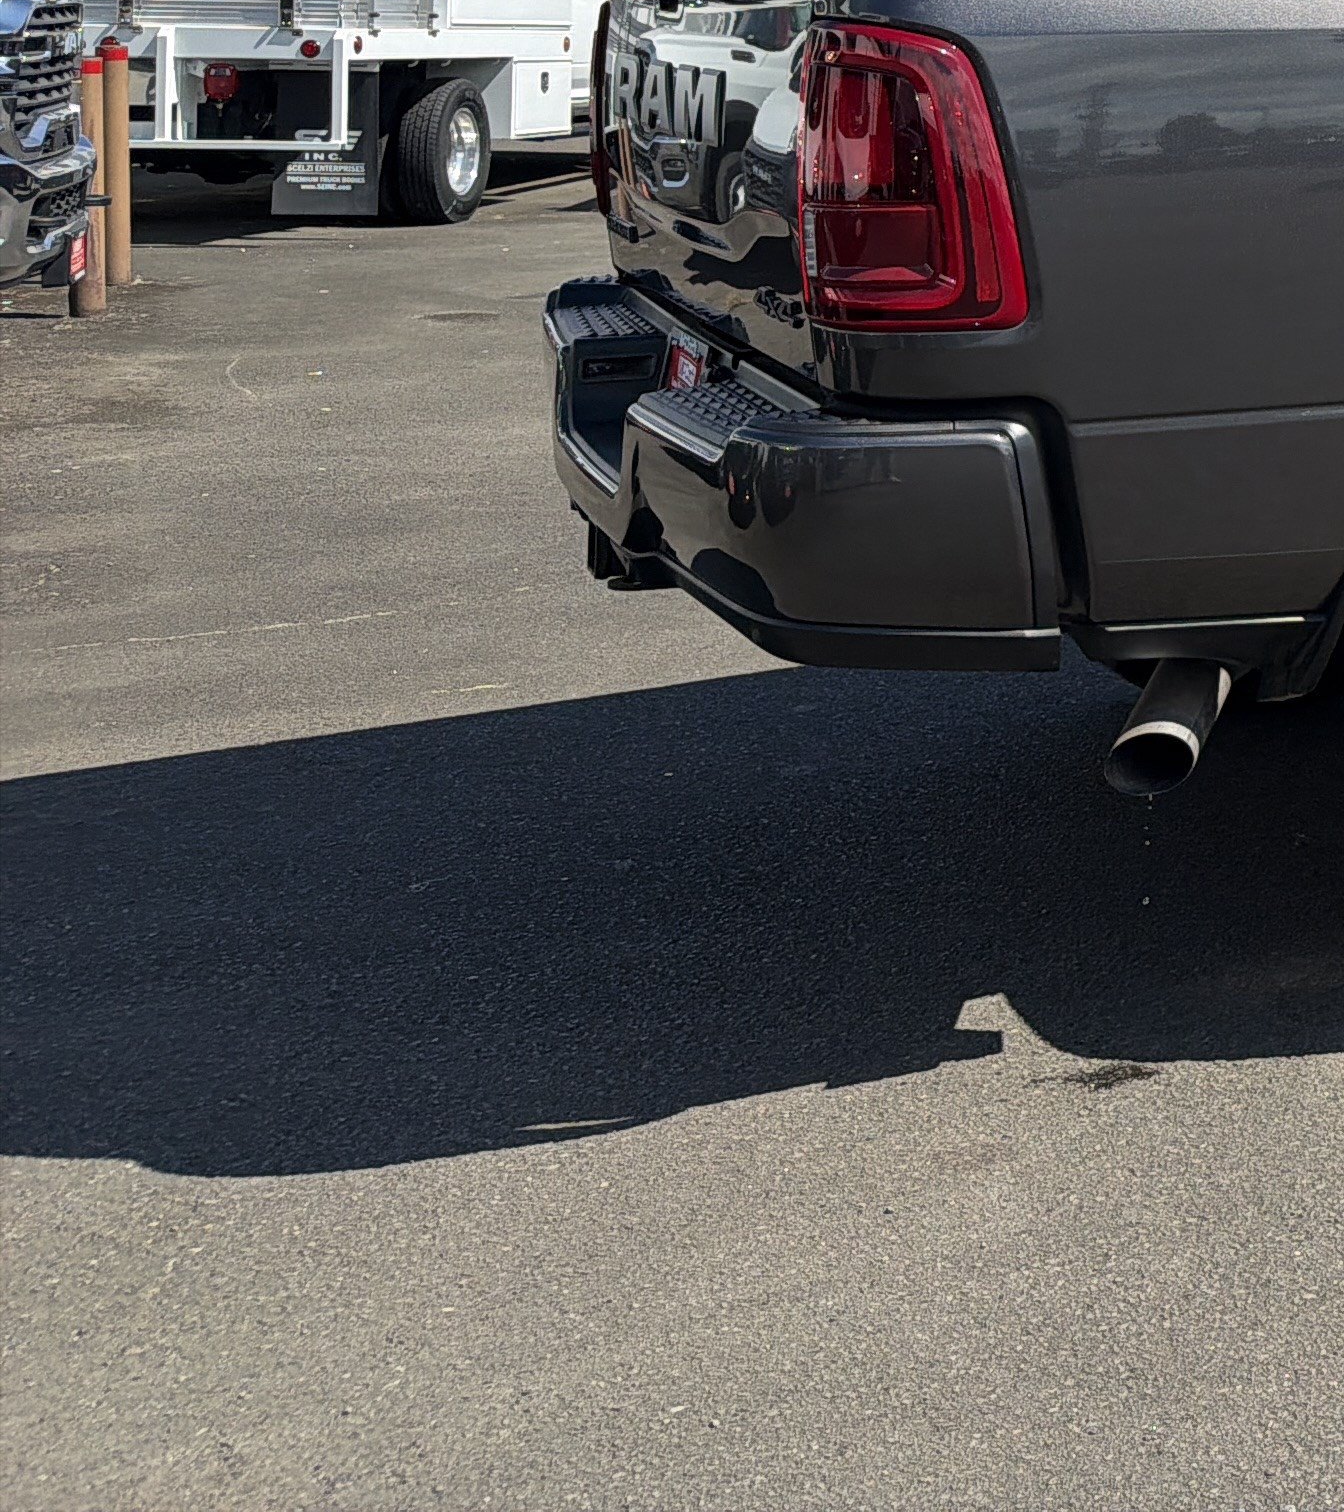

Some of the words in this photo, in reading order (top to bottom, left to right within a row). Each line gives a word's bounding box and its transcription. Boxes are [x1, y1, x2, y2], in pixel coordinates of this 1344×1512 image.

[612, 51, 726, 148] RAM
[304, 152, 343, 161] INC.
[315, 164, 366, 173] ENTERPRISES
